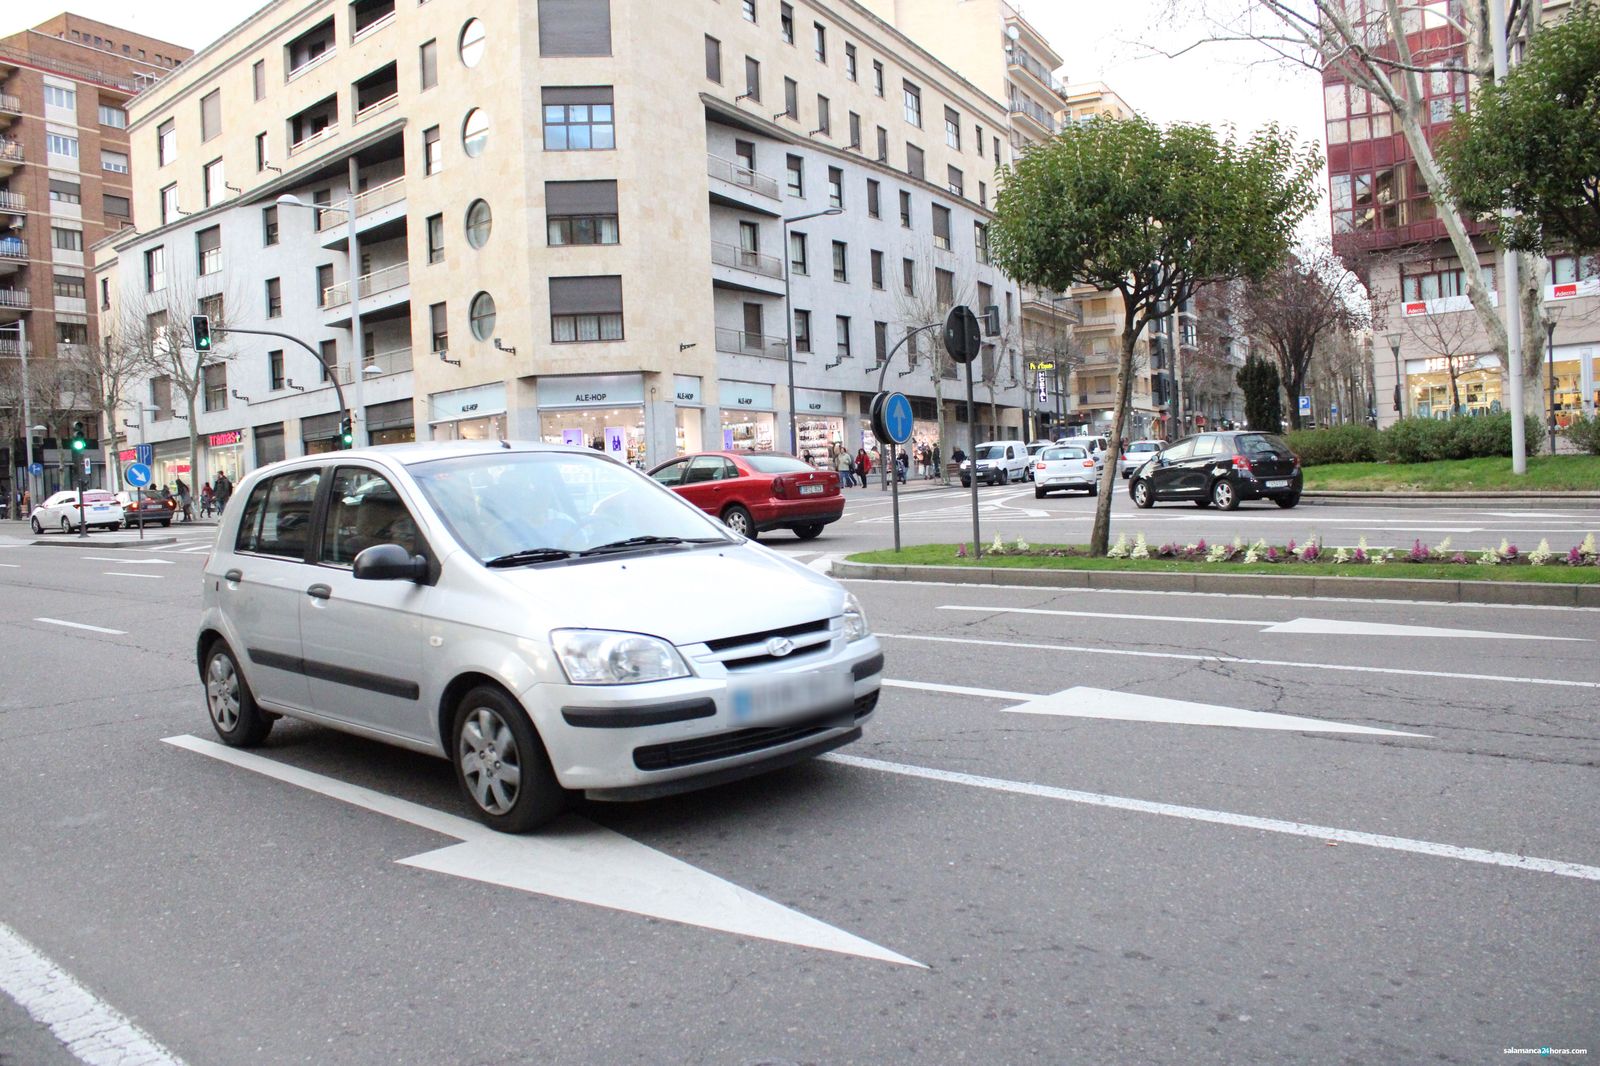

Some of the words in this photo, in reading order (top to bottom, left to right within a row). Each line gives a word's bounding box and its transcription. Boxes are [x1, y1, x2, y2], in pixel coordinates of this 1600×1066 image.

[1038, 371, 1046, 402] HOSTAL
[575, 393, 607, 401] ALE-HOP
[677, 392, 694, 400] ALE-HOP
[1299, 398, 1308, 408] P
